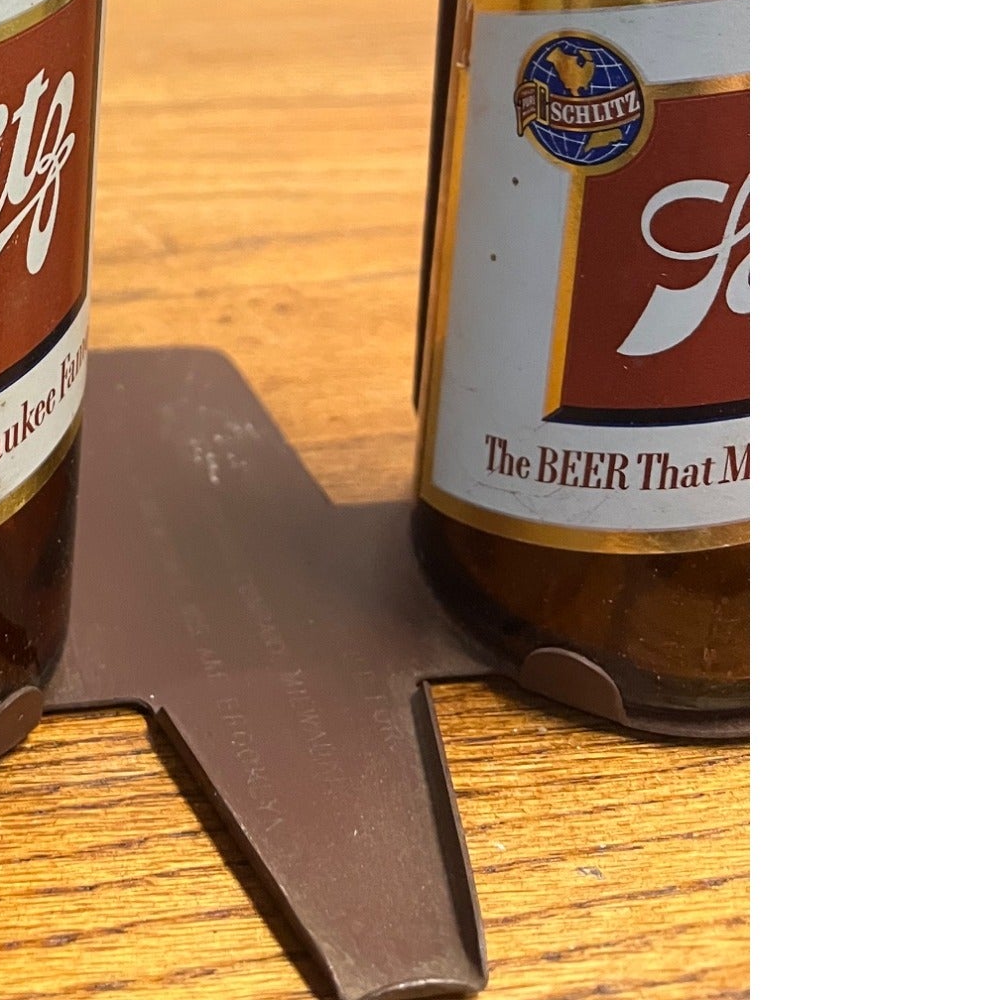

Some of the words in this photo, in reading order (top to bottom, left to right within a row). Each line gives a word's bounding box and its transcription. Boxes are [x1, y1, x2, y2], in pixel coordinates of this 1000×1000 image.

[550, 90, 640, 124] SCHLITZ
[485, 434, 530, 479] The
[534, 445, 630, 490] BEER
[636, 453, 716, 490] That
